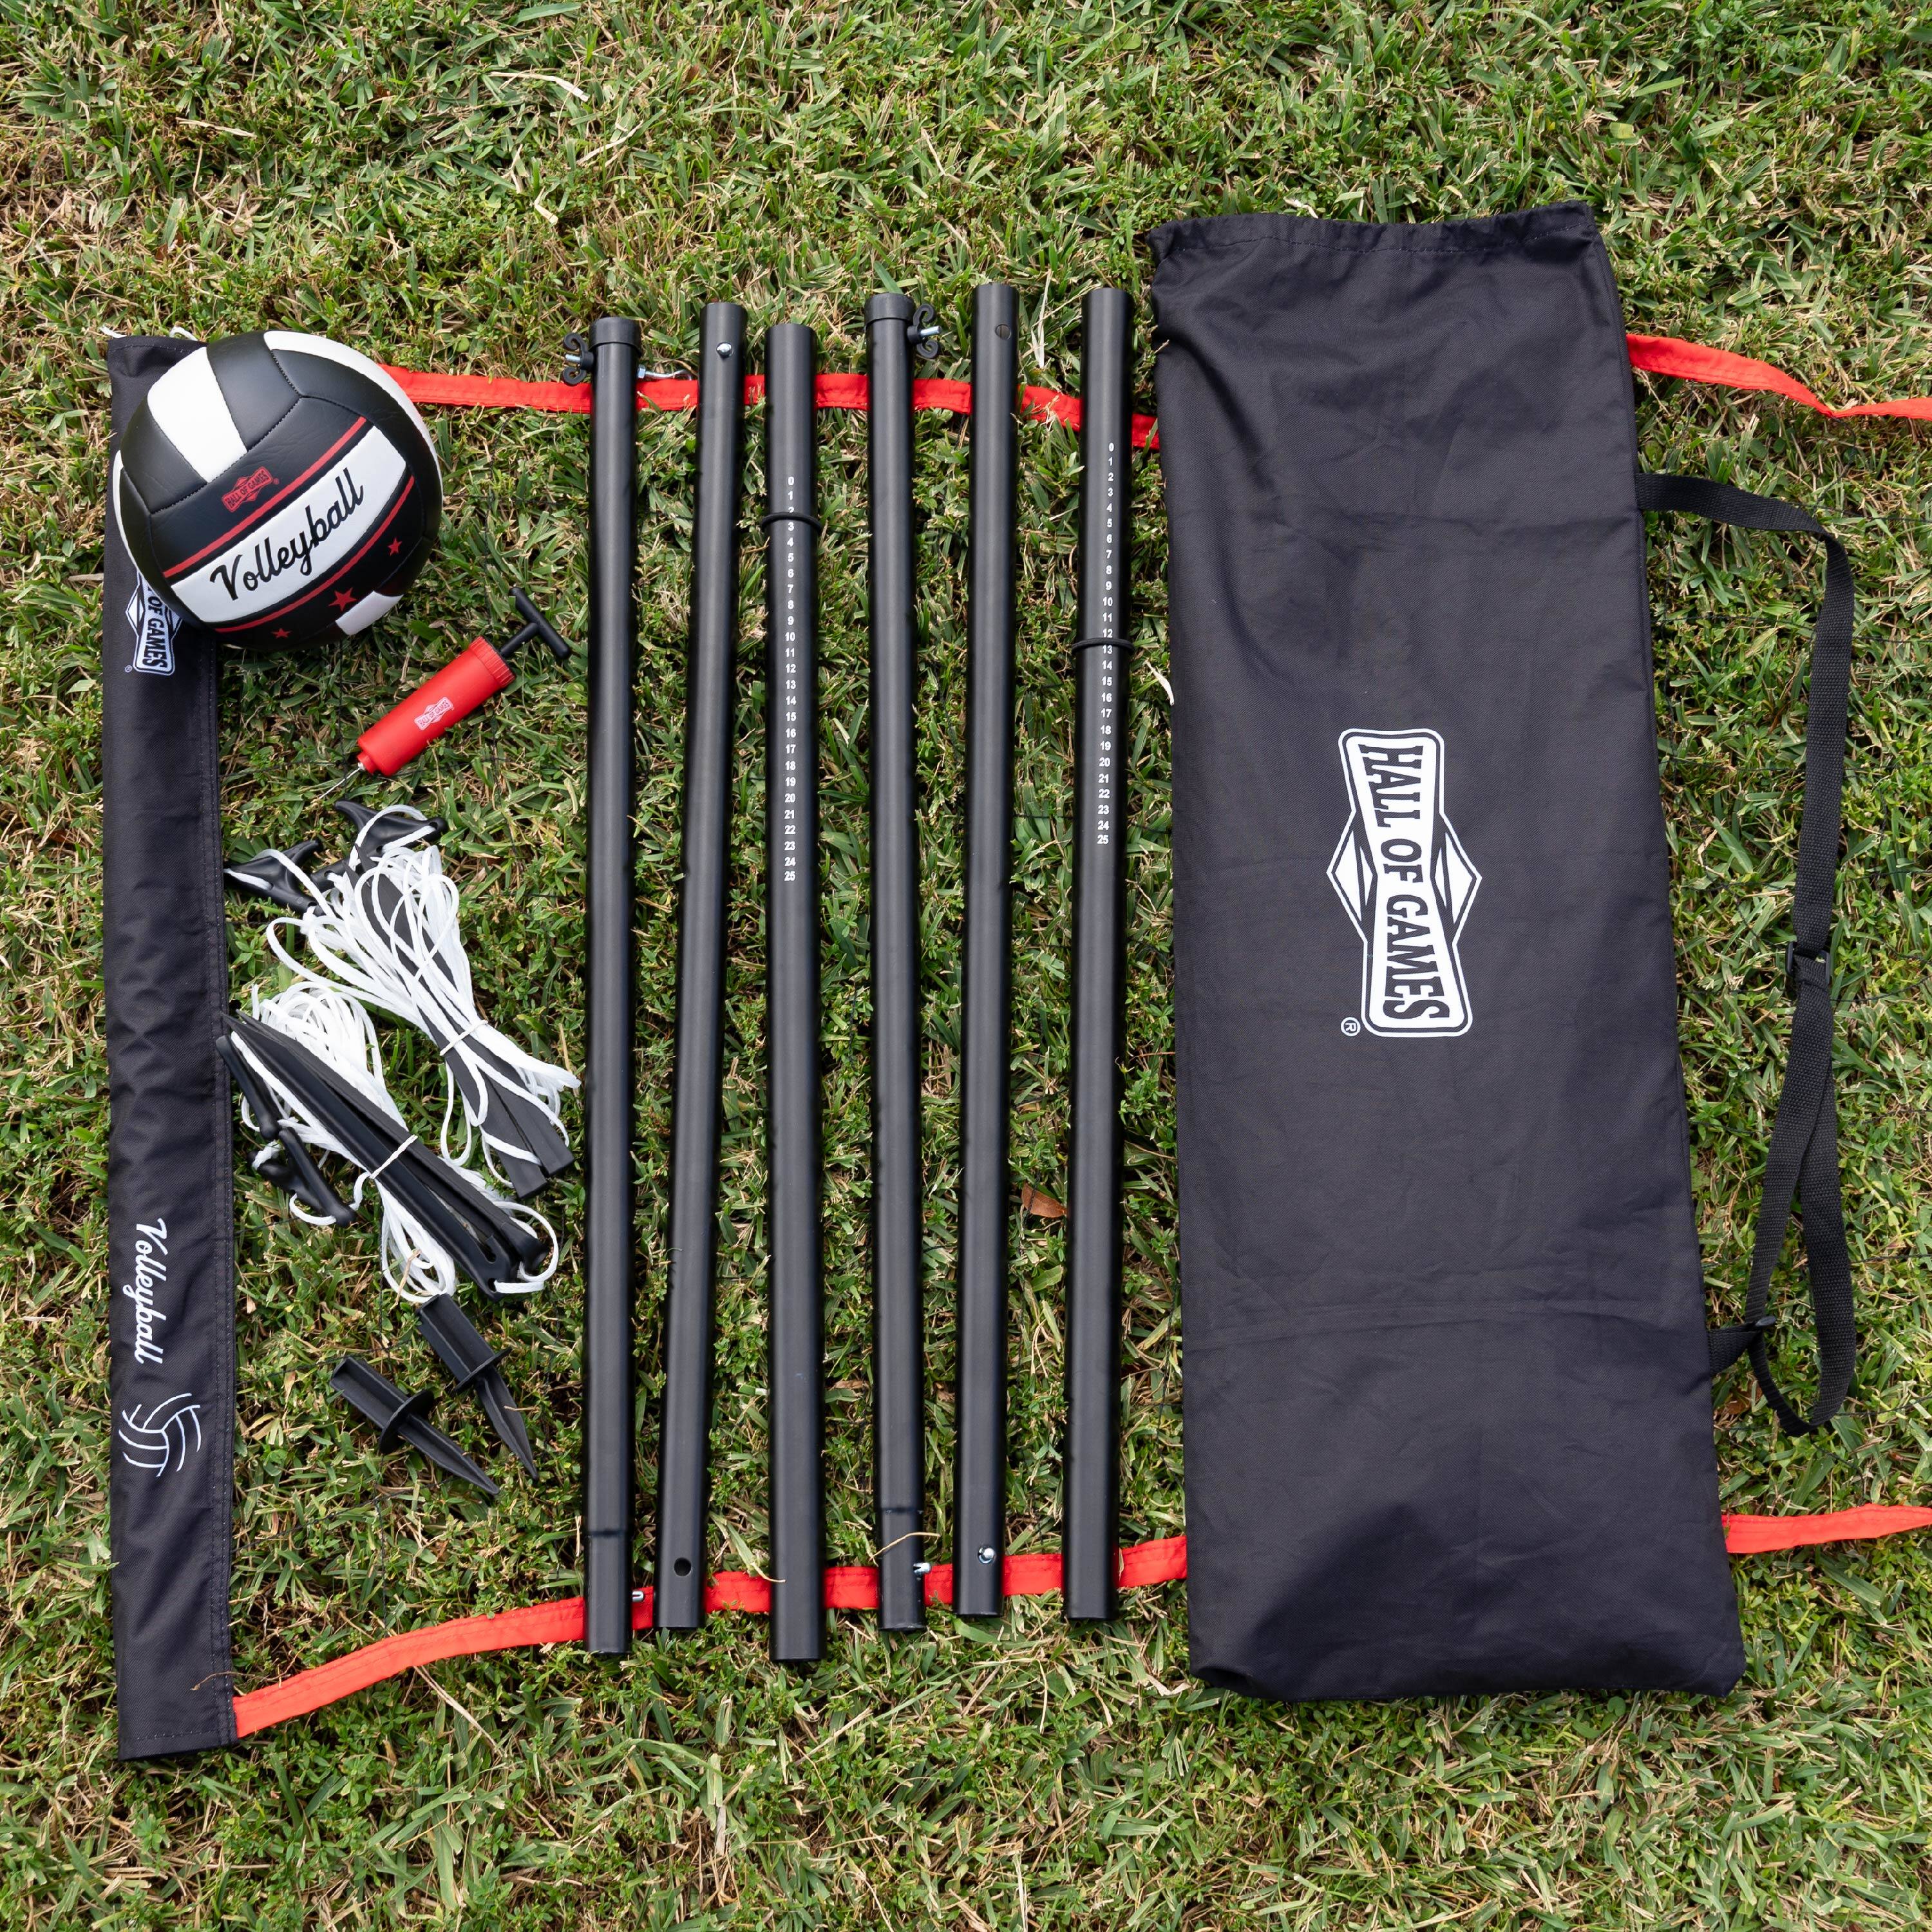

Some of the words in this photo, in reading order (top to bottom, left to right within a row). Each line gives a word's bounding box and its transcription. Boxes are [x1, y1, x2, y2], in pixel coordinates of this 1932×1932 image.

[1108, 442, 1115, 452] 0
[1108, 457, 1113, 466] 1
[788, 476, 795, 486] 0
[1107, 471, 1114, 482] 2
[225, 493, 242, 507] HALL
[240, 486, 248, 495] OF
[247, 470, 270, 489] GAMES
[1106, 487, 1113, 497] 3
[788, 490, 793, 500] 1
[1105, 502, 1113, 513] 4
[788, 522, 795, 531] 3
[1106, 518, 1113, 528] 5
[210, 468, 365, 601] Volleyball
[1105, 533, 1112, 544] 6
[786, 537, 794, 547] 4
[788, 553, 795, 563] 5
[1105, 549, 1112, 559] 7
[787, 568, 795, 578] 6
[1105, 565, 1112, 575] 8
[787, 583, 794, 594] 7
[1104, 580, 1112, 591] 9
[147, 596, 164, 616] OF
[787, 600, 795, 610] 8
[1102, 596, 1113, 607] 10
[787, 616, 795, 626] 9
[1102, 612, 1113, 623] 11
[784, 631, 796, 642] 10
[1102, 628, 1113, 638] 12
[142, 618, 168, 668] GAMES
[785, 647, 795, 658] 11
[1102, 645, 1113, 654] 13
[785, 663, 797, 674] 12
[1102, 659, 1113, 670] 14
[785, 679, 797, 690] 13
[1101, 676, 1112, 687] 15
[786, 695, 797, 706] 14
[1101, 692, 1112, 703] 16
[786, 711, 797, 722] 15
[1101, 708, 1112, 718] 17
[785, 728, 797, 739] 16
[1100, 724, 1112, 735] 18
[785, 744, 797, 754] 17
[1100, 741, 1112, 751] 19
[785, 761, 796, 771] 18
[1099, 757, 1111, 767] 20
[785, 777, 796, 787] 19
[1098, 773, 1109, 784] 21
[1358, 744, 1424, 828] HALL
[784, 793, 796, 803] 20
[1098, 788, 1110, 799] 22
[784, 810, 795, 820] 21
[1097, 804, 1110, 815] 23
[784, 824, 796, 835] 22
[1097, 820, 1110, 831] 24
[1097, 834, 1109, 845] 25
[784, 840, 796, 851] 23
[784, 857, 796, 867] 24
[1380, 838, 1424, 884] OF
[784, 871, 796, 882] 25
[1382, 894, 1451, 1019] GAMES
[122, 1218, 169, 1365] Volleyball
